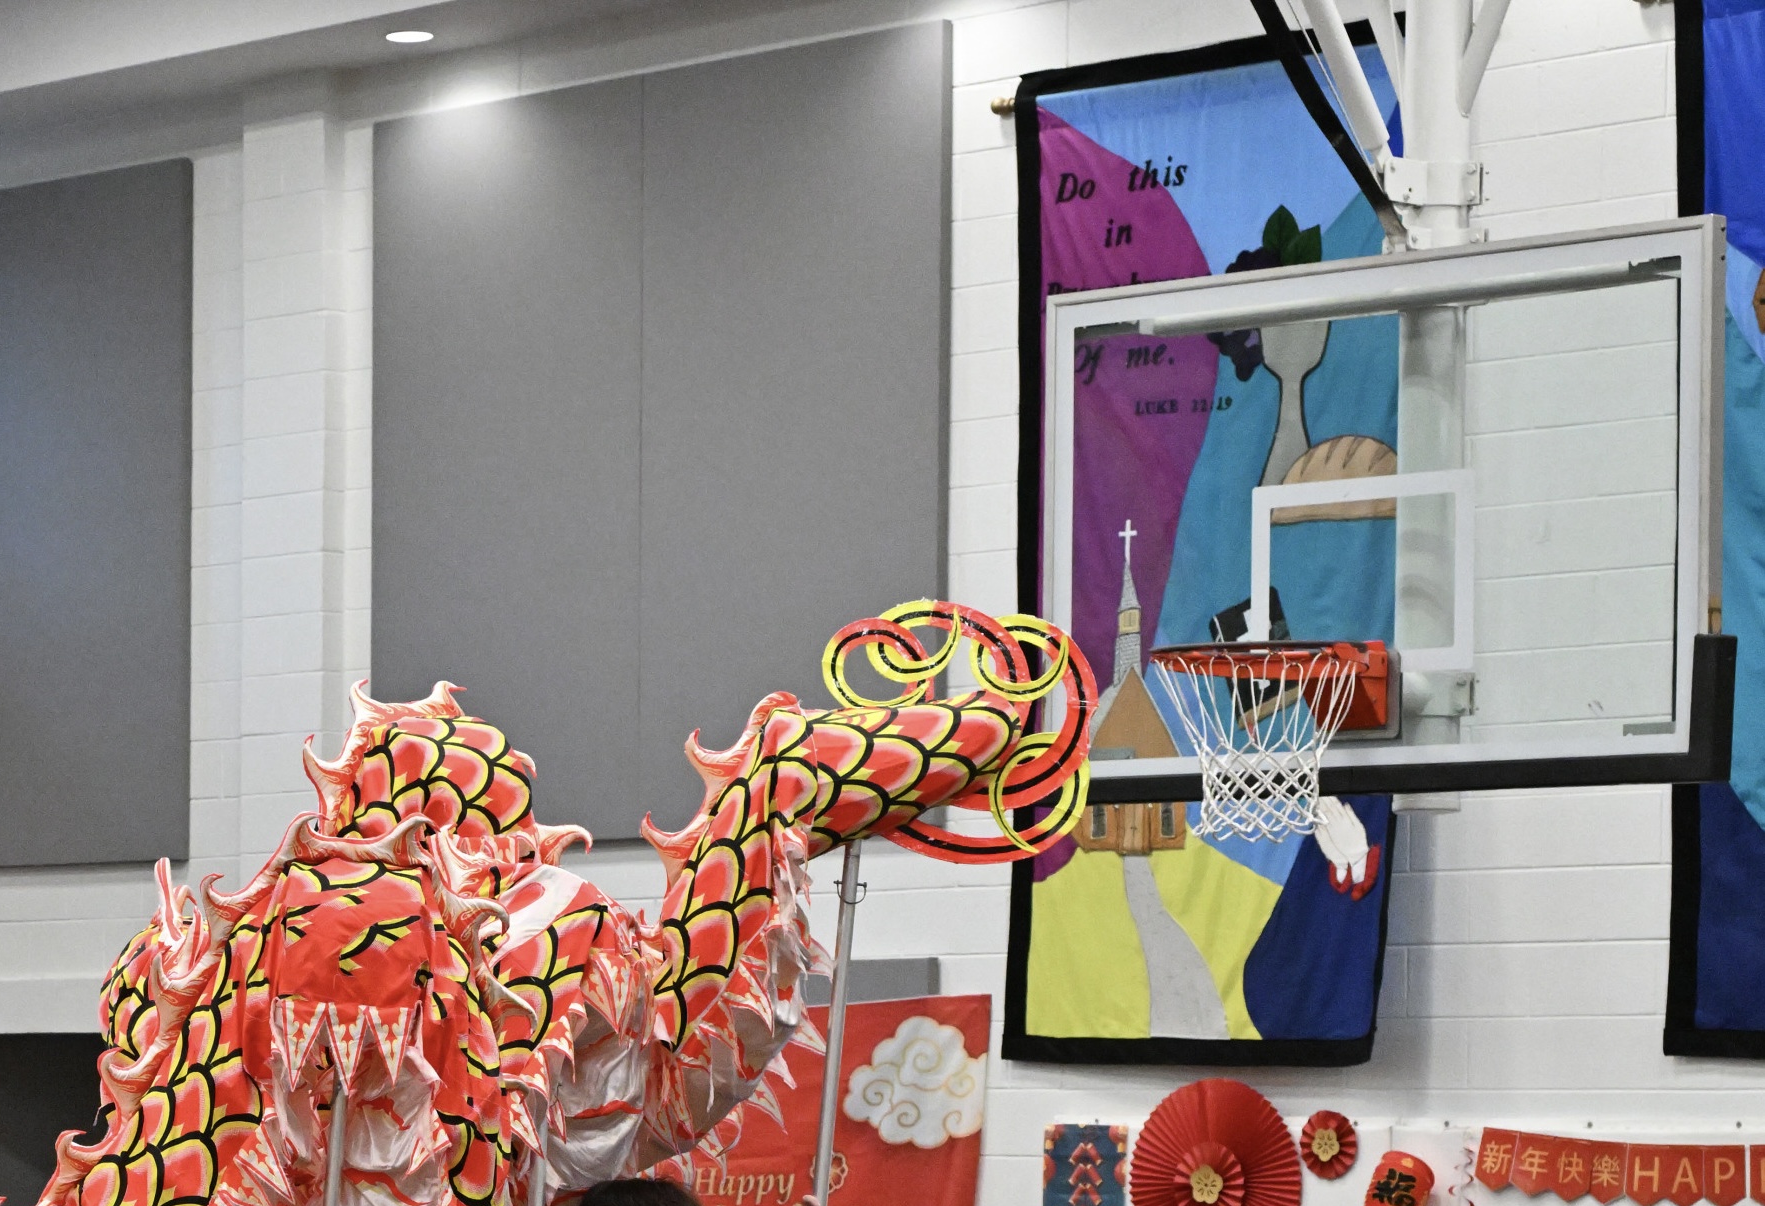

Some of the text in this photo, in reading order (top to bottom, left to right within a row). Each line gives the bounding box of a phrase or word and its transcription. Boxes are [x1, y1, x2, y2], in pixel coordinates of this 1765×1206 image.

[1055, 155, 1188, 204] Do this
[1104, 218, 1132, 248] in
[1126, 343, 1174, 369] me.
[1135, 398, 1178, 415] LUKE
[1482, 1140, 1621, 1188] 新年快樂
[1632, 1156, 1765, 1194] HAP
[694, 1166, 795, 1206] Happy
